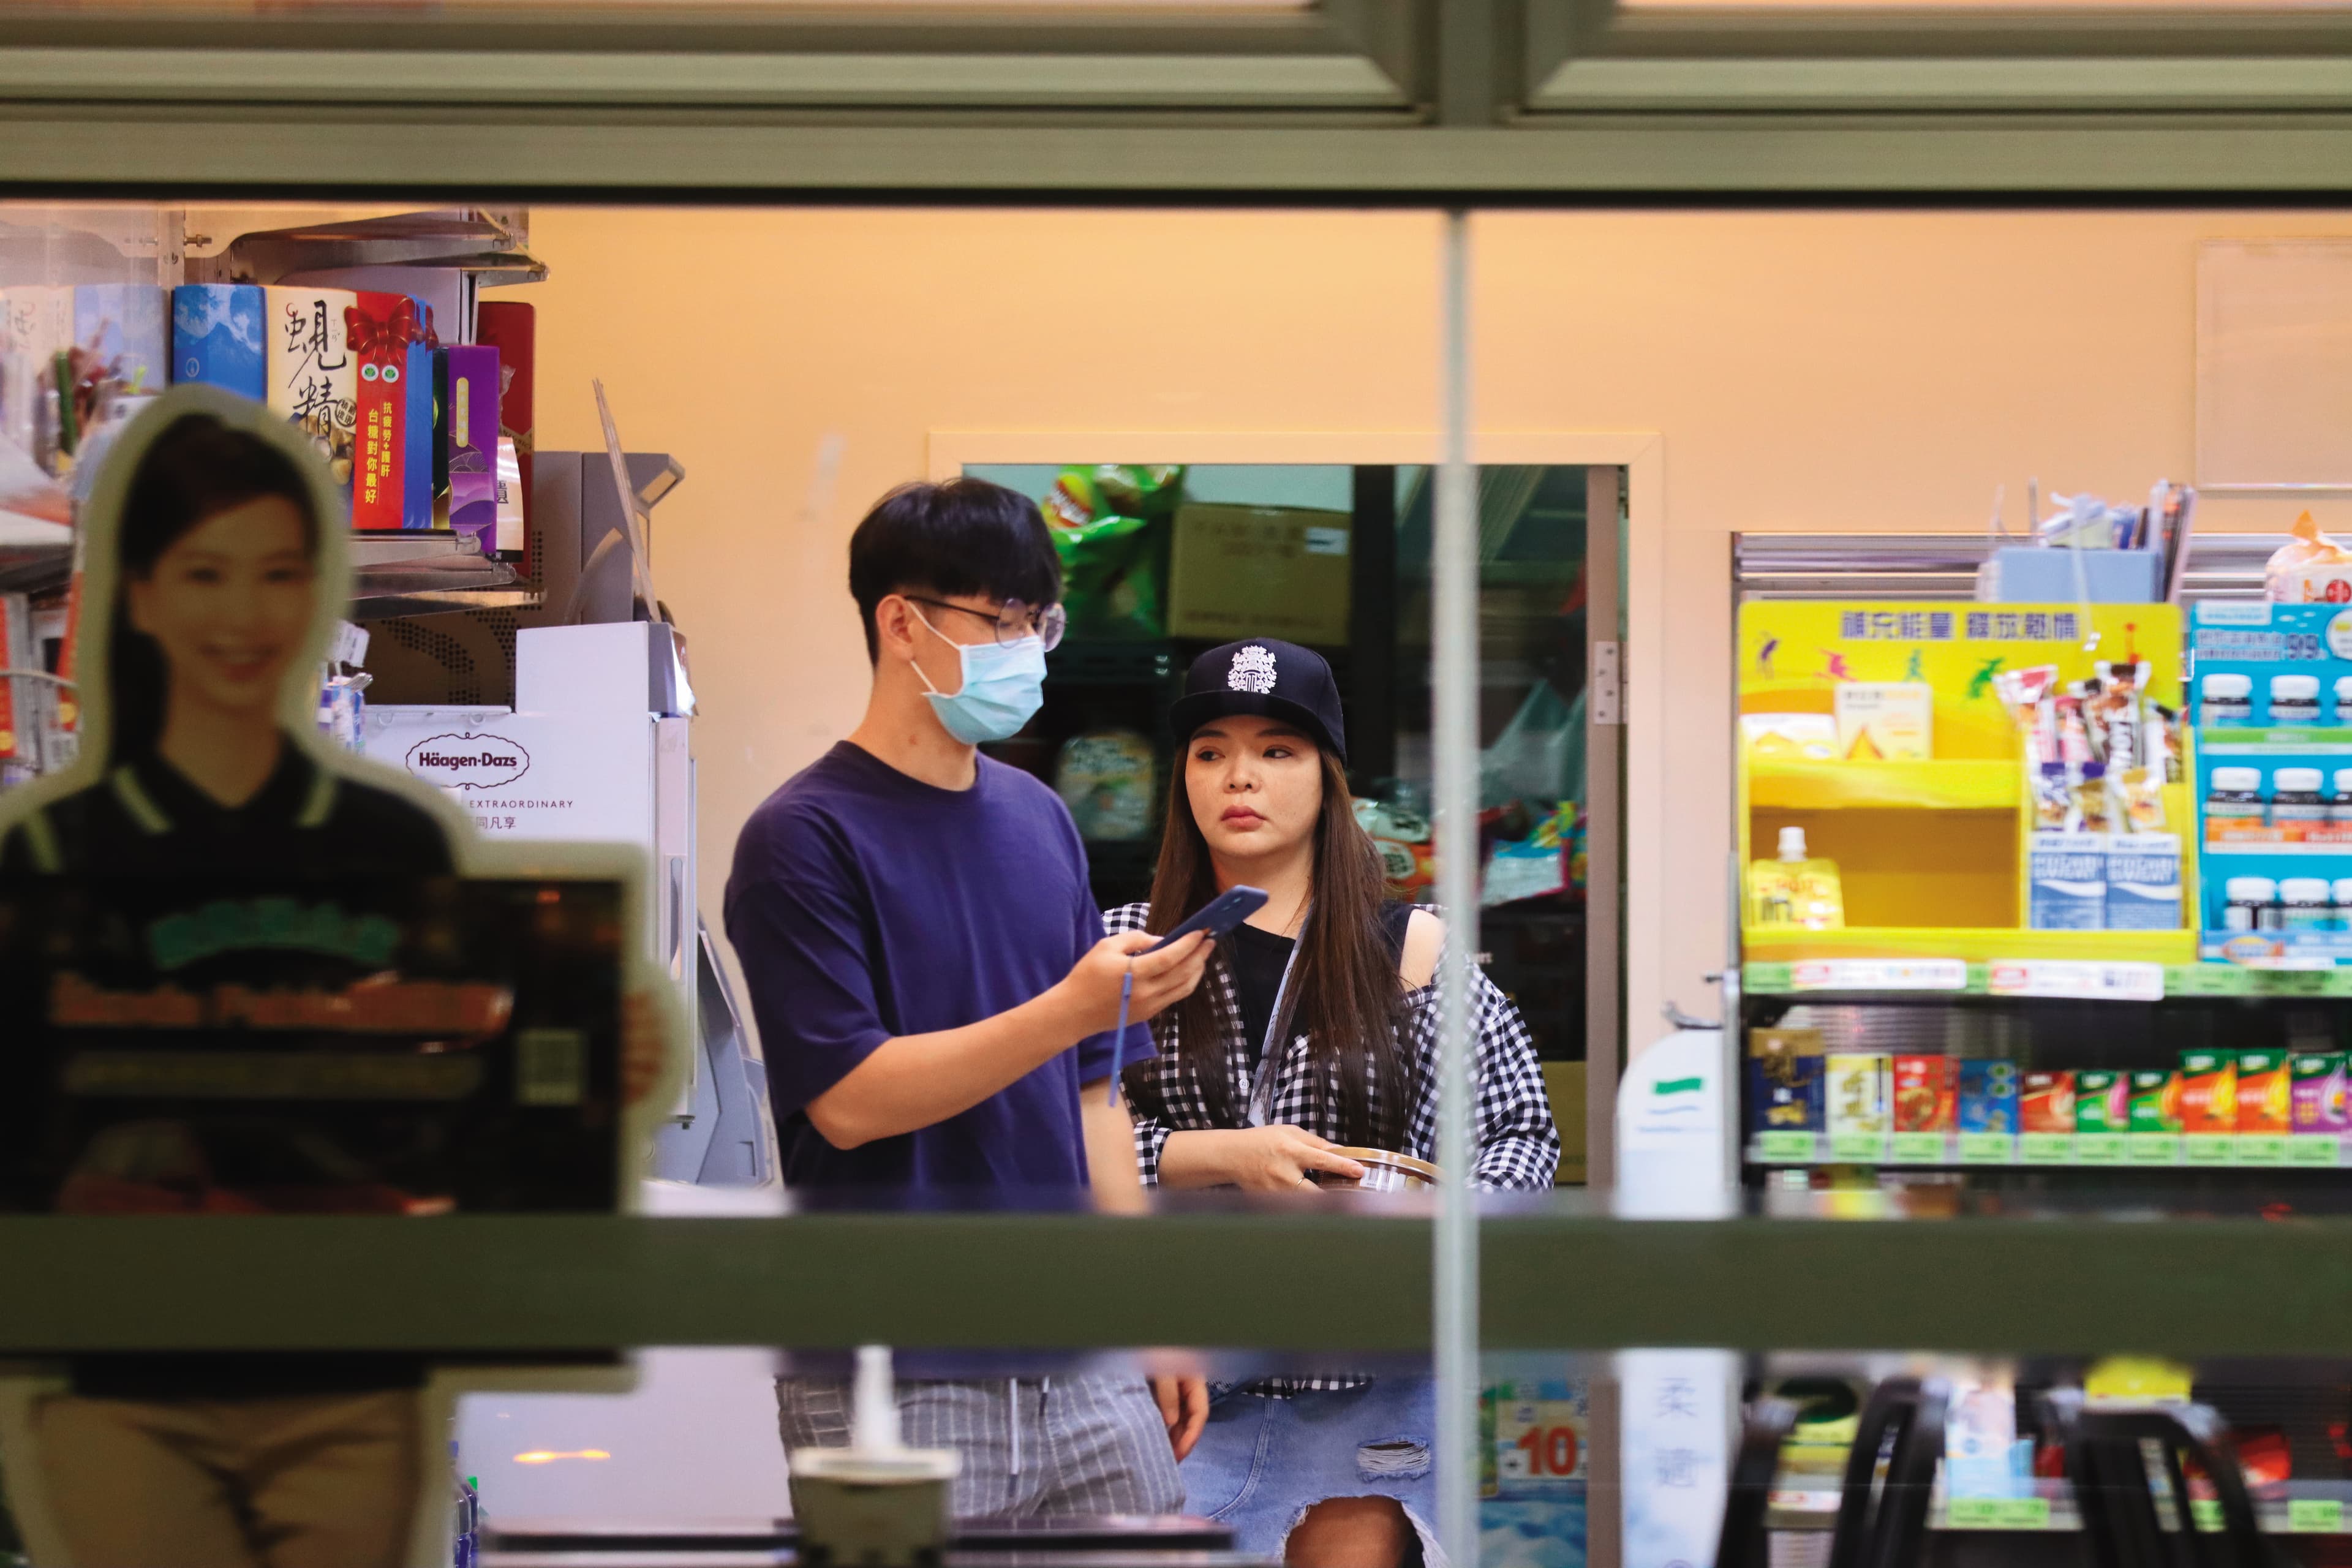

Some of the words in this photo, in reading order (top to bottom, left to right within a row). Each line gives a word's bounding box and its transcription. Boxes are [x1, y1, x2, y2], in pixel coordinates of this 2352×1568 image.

[365, 409, 379, 503] 台糖對你最好
[380, 402, 393, 477] 抗疲勞+護肝
[419, 752, 517, 771] Häagen-Dazs
[469, 800, 573, 809] EXTRAORDINARY
[468, 816, 516, 829] 同凡享
[1517, 1426, 1577, 1476] 10
